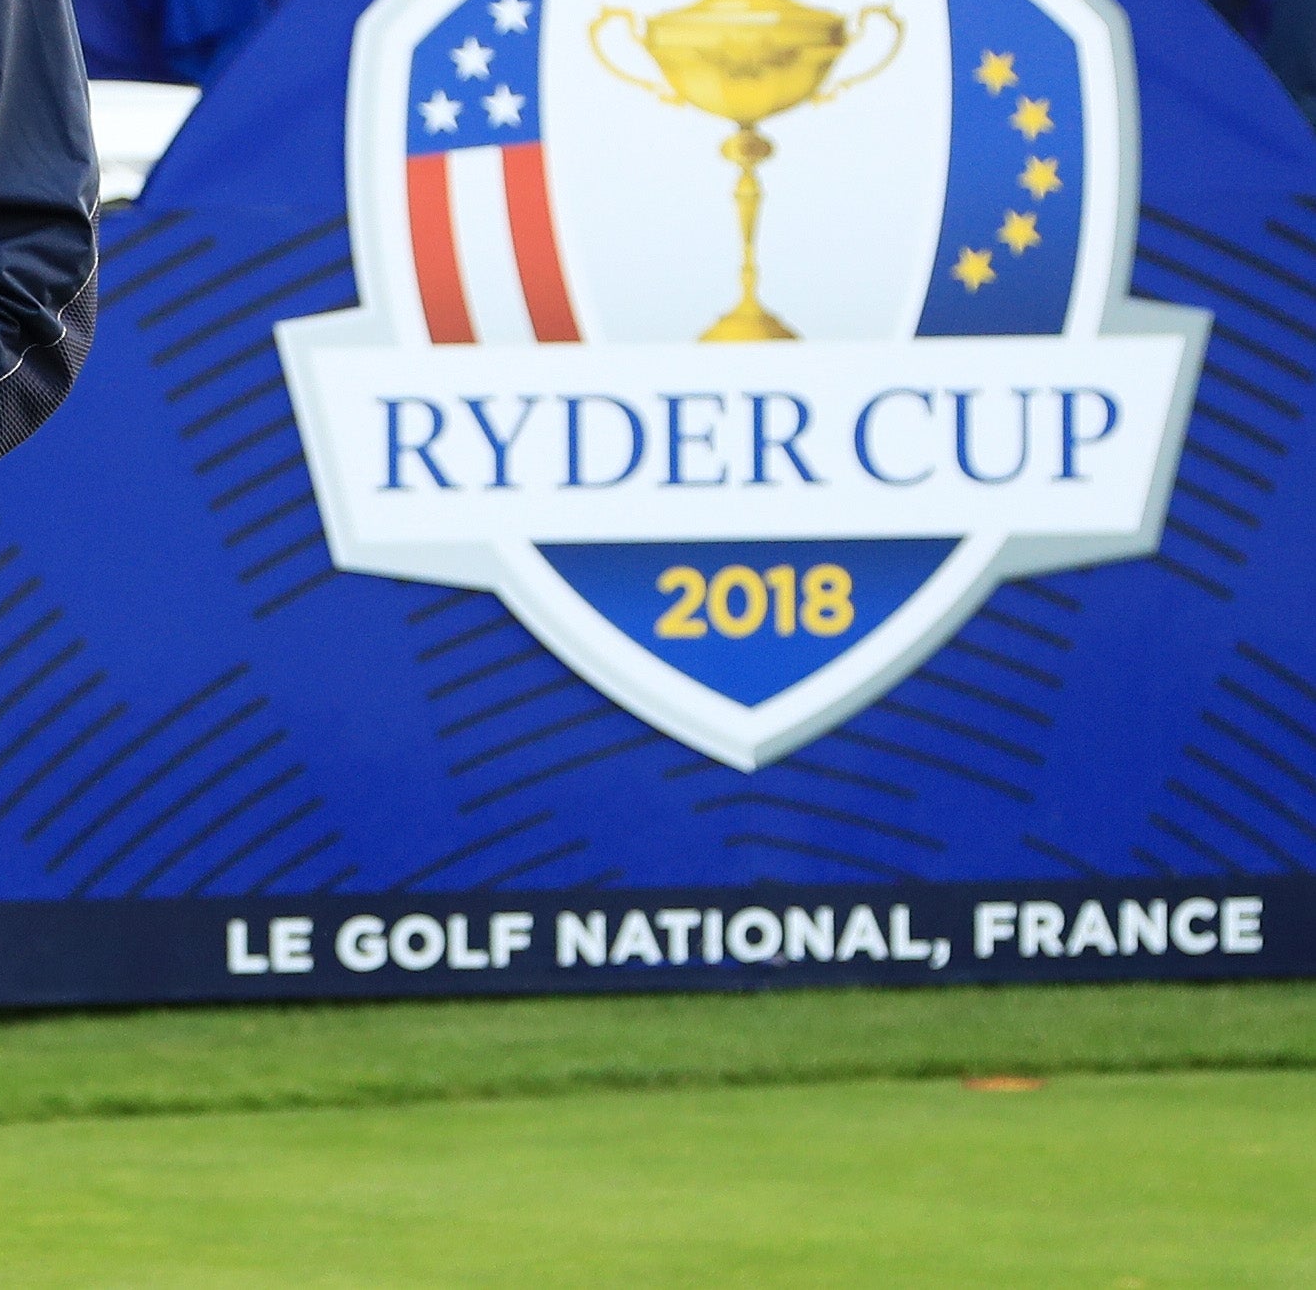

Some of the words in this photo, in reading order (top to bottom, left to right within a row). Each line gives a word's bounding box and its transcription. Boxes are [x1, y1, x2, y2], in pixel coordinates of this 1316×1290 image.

[374, 392, 828, 494] RYDER
[852, 386, 1121, 486] CUP
[654, 563, 856, 639] 2018
[226, 918, 314, 974] LE
[334, 911, 534, 972] GOLF
[555, 903, 951, 970] NATIONAL,
[973, 896, 1264, 959] FRANCE
